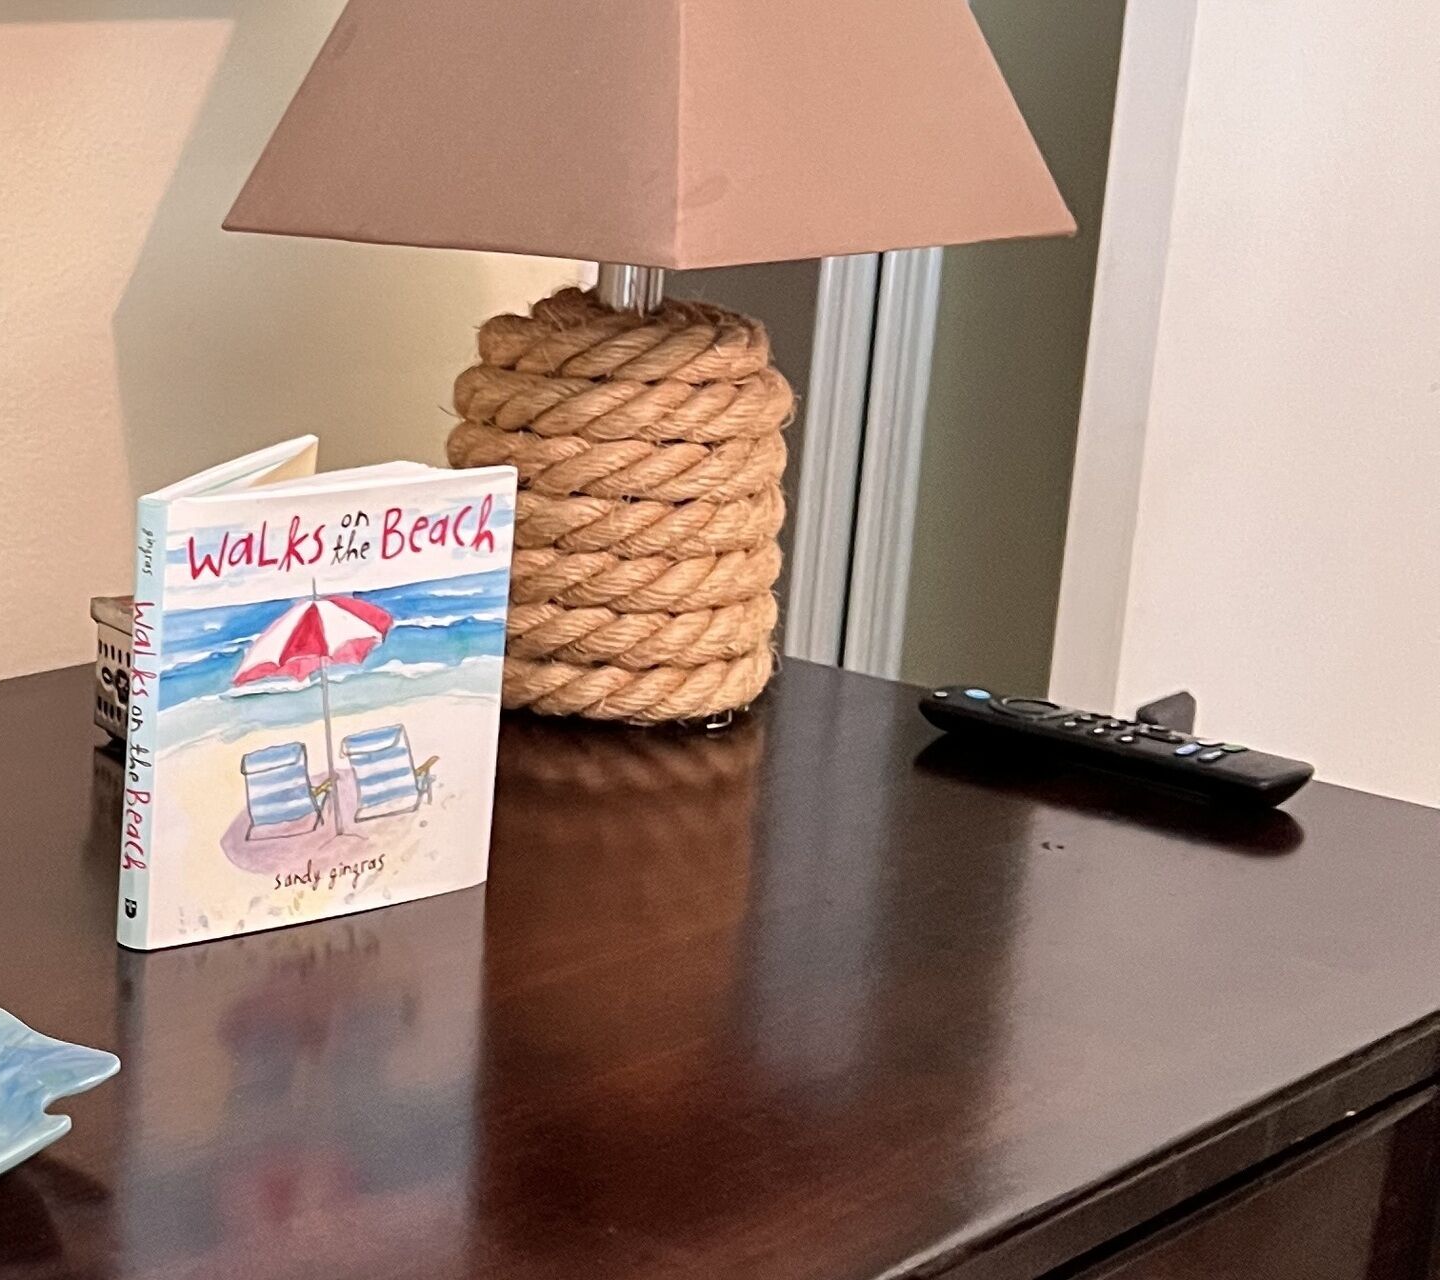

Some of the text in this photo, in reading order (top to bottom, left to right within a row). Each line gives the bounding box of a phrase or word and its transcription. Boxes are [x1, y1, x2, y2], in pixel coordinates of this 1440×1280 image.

[341, 509, 370, 529] on
[381, 493, 496, 560] Beach
[137, 527, 156, 577] gingras
[331, 530, 371, 565] the
[130, 705, 144, 732] on
[128, 744, 153, 783] the
[122, 788, 152, 870] Beach
[274, 853, 386, 891] sandy gingras
